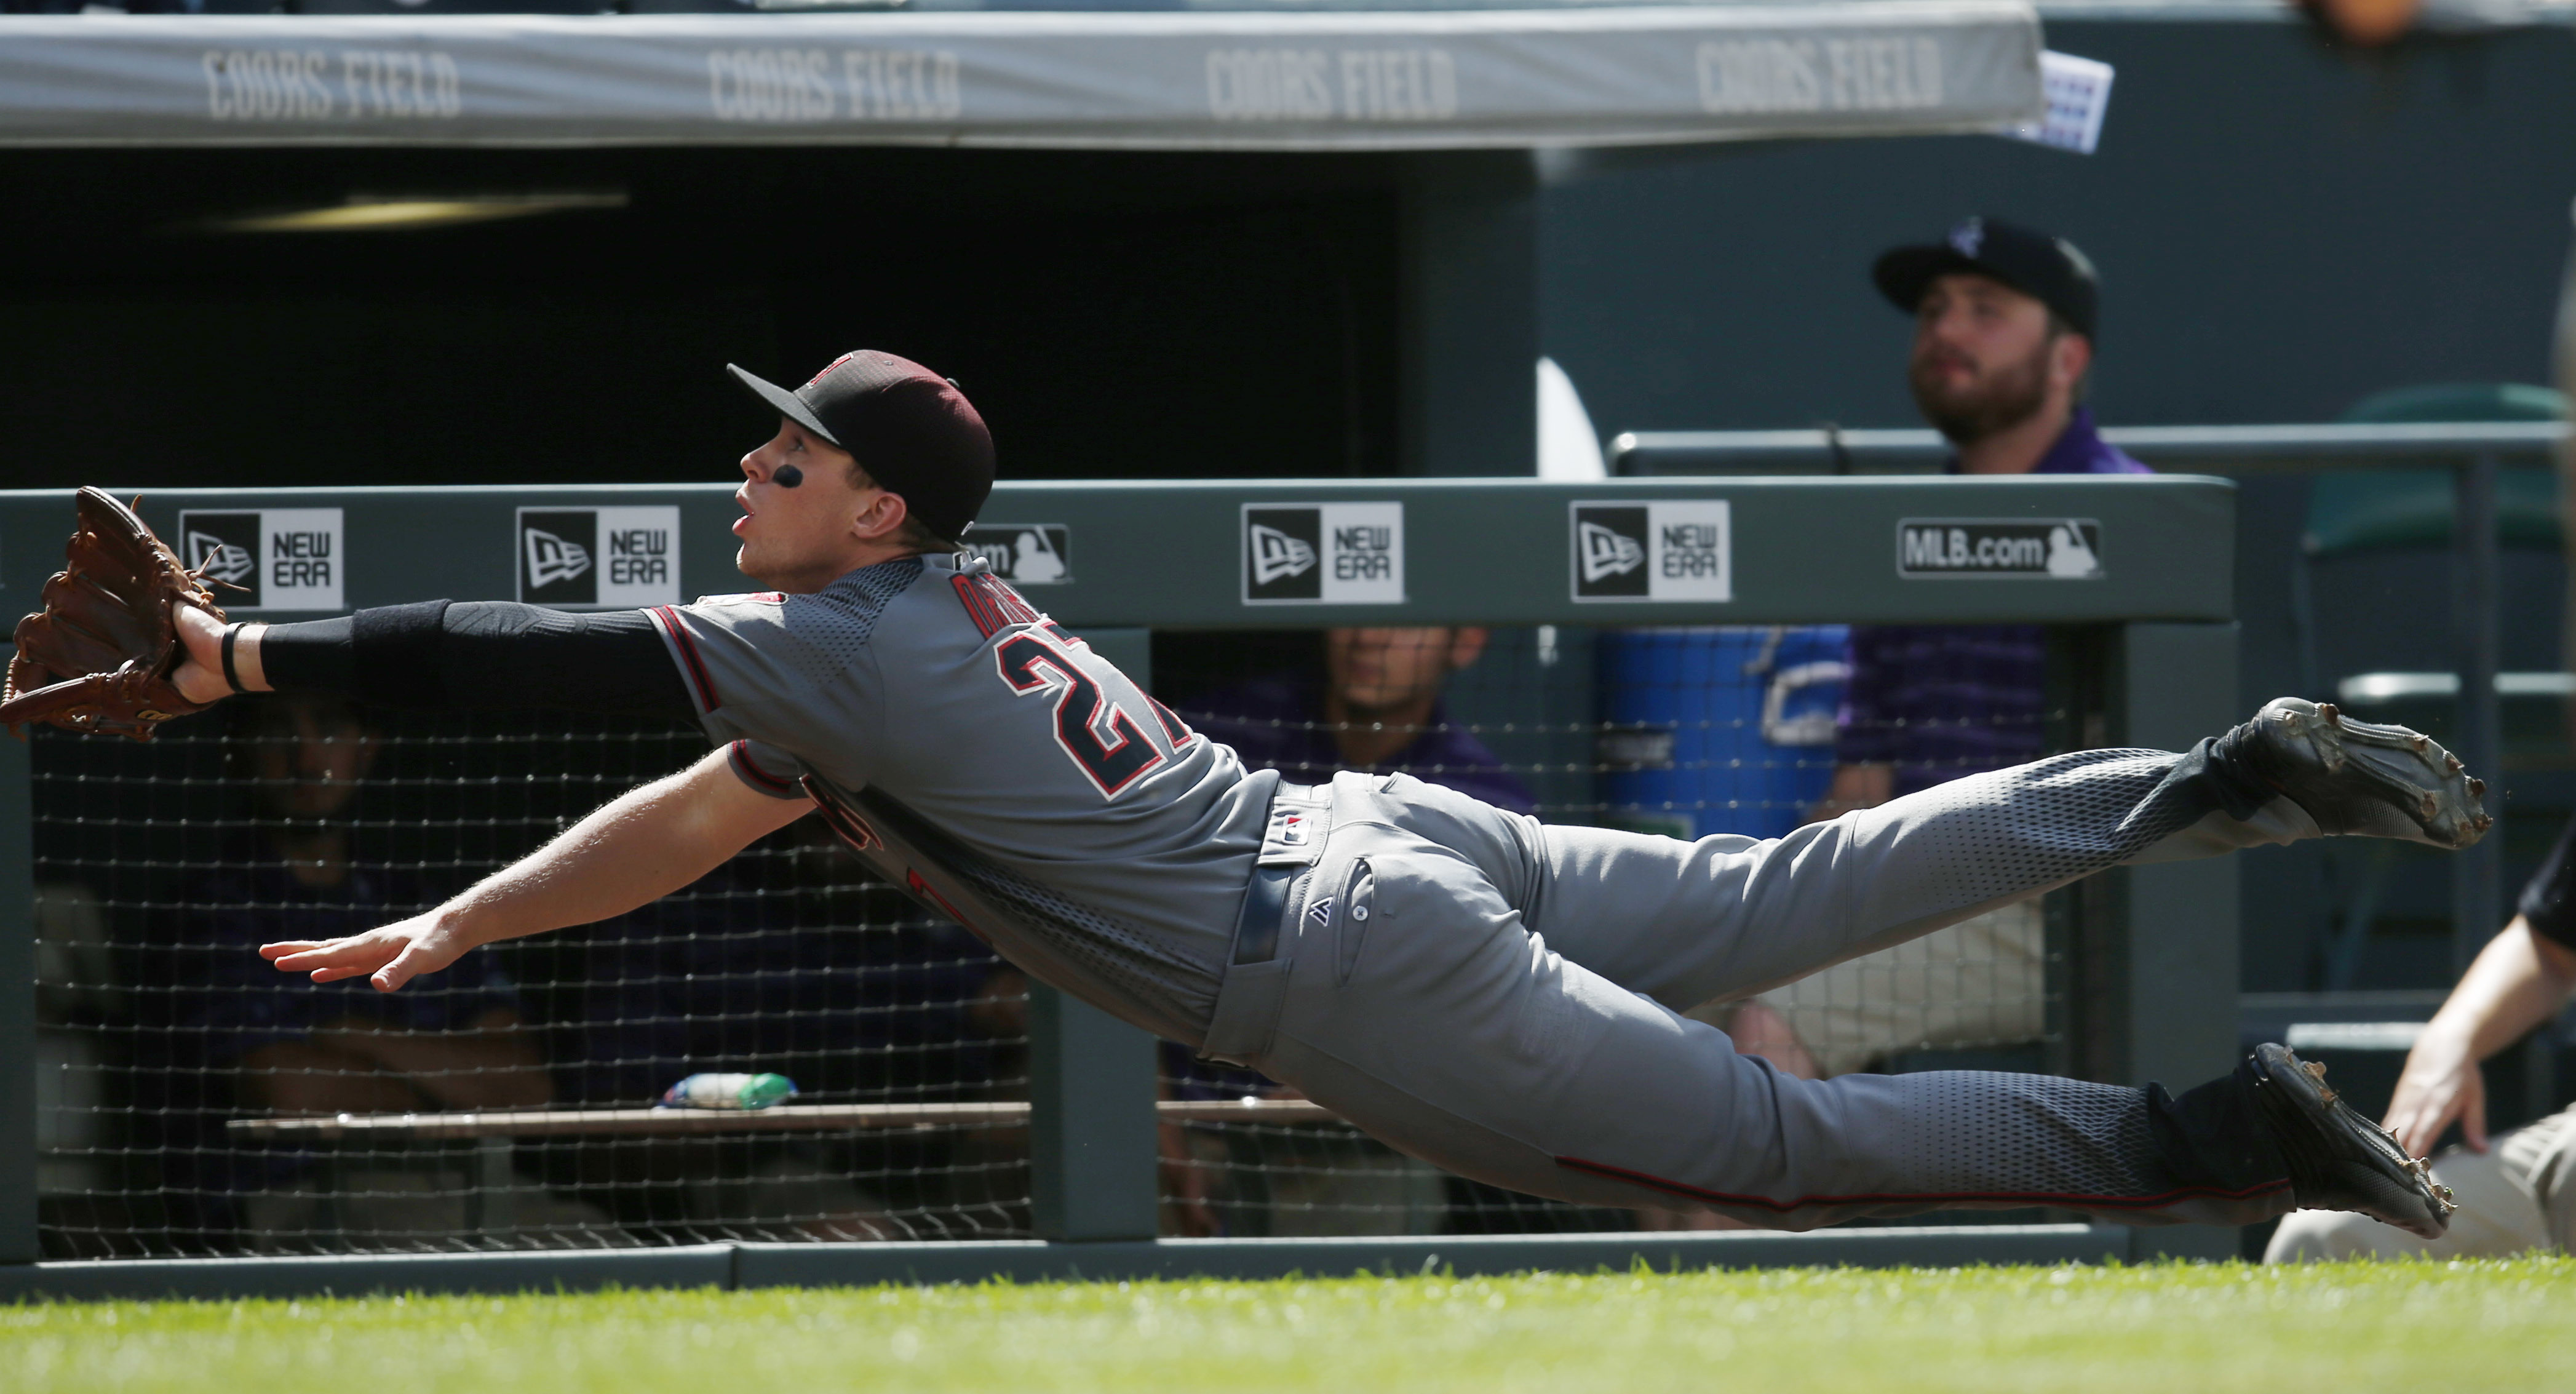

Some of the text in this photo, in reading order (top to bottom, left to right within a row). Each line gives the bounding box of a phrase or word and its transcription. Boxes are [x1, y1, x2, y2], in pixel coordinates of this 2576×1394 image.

[204, 50, 459, 119] COORS FIELD
[709, 49, 960, 120] COORS FIELD
[1206, 49, 1457, 120] COORS FIELD
[1696, 37, 1941, 112] COORS FIELD
[274, 532, 330, 558] NEW
[611, 530, 667, 555] NEW
[1335, 527, 1389, 550] NEW
[1663, 525, 1717, 548] NEW
[1906, 528, 2044, 567] MLB.com
[274, 561, 330, 587] ERA
[611, 559, 667, 584] ERA
[1335, 555, 1389, 580] ERA
[1663, 553, 1717, 577] ERA
